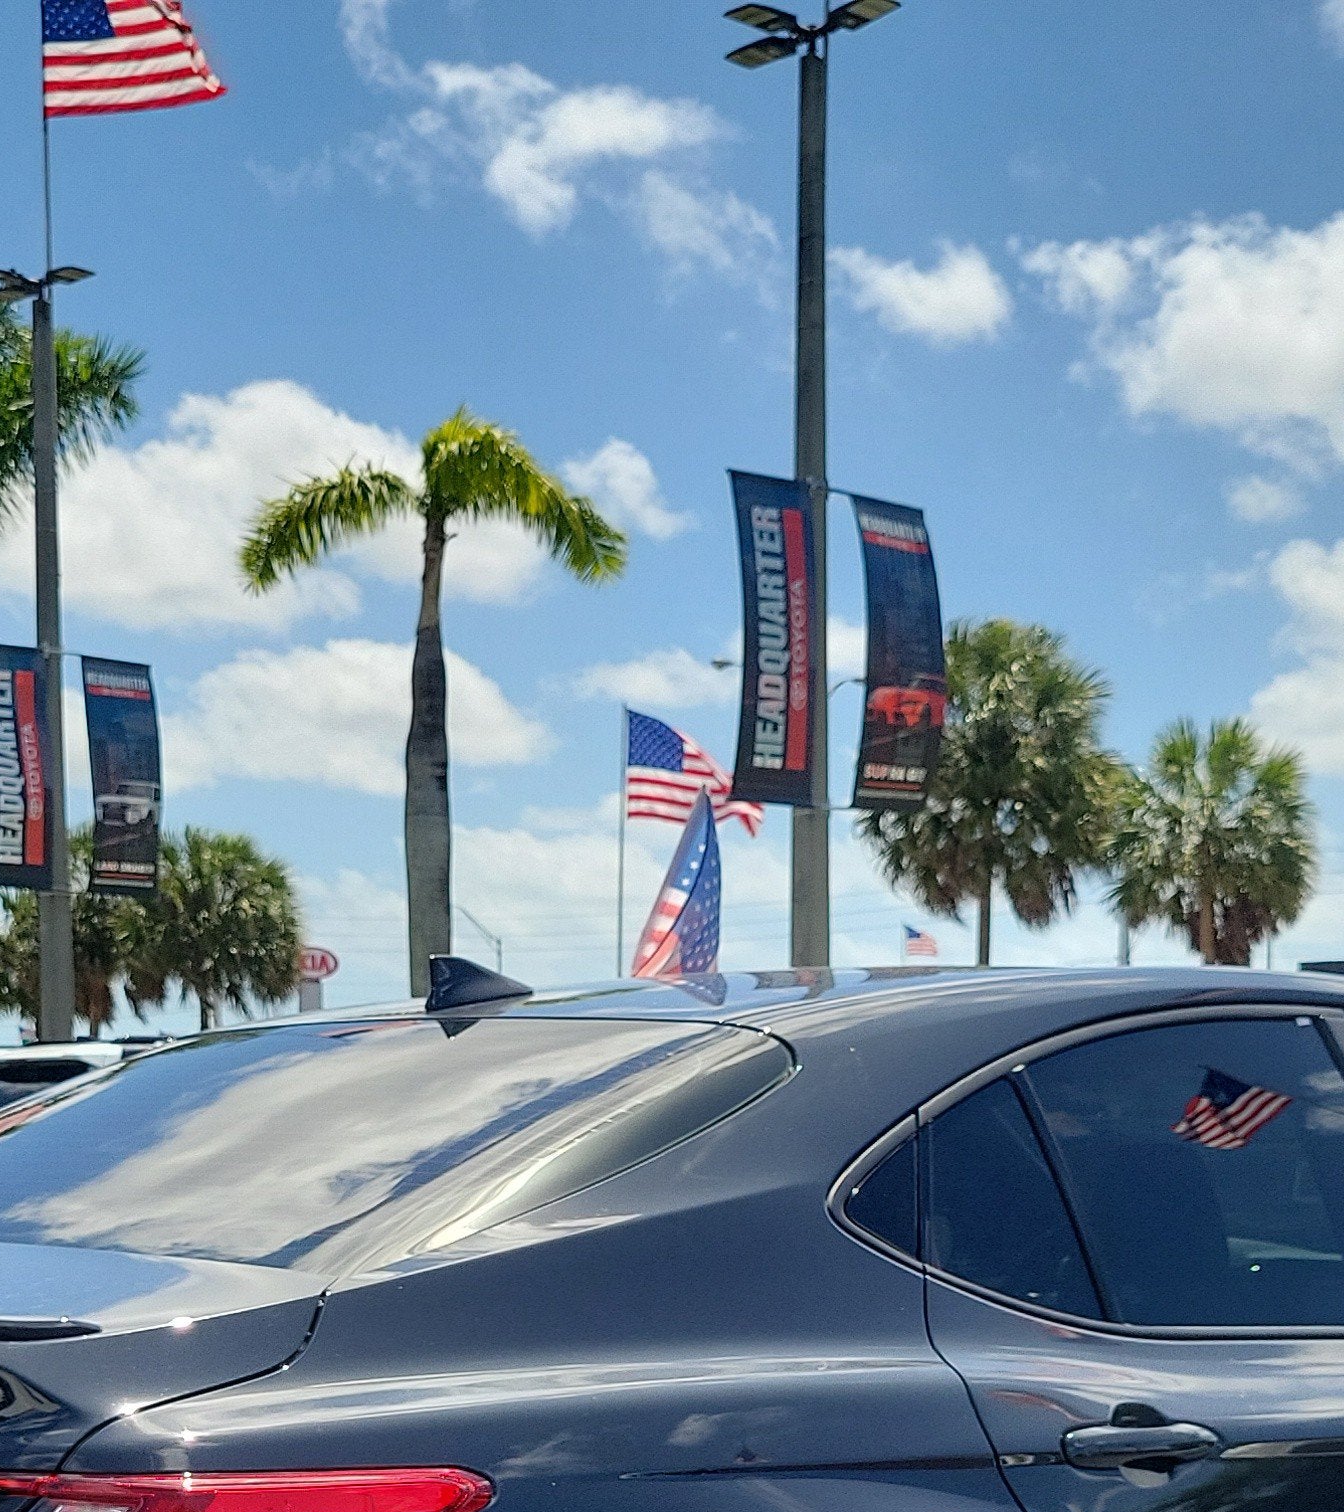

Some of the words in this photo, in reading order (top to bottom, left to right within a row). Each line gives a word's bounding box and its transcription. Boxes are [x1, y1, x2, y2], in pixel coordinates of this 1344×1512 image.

[751, 507, 788, 769] HEADQUARTER
[789, 580, 806, 675] TOYOTA
[22, 722, 43, 795] TOYOTA
